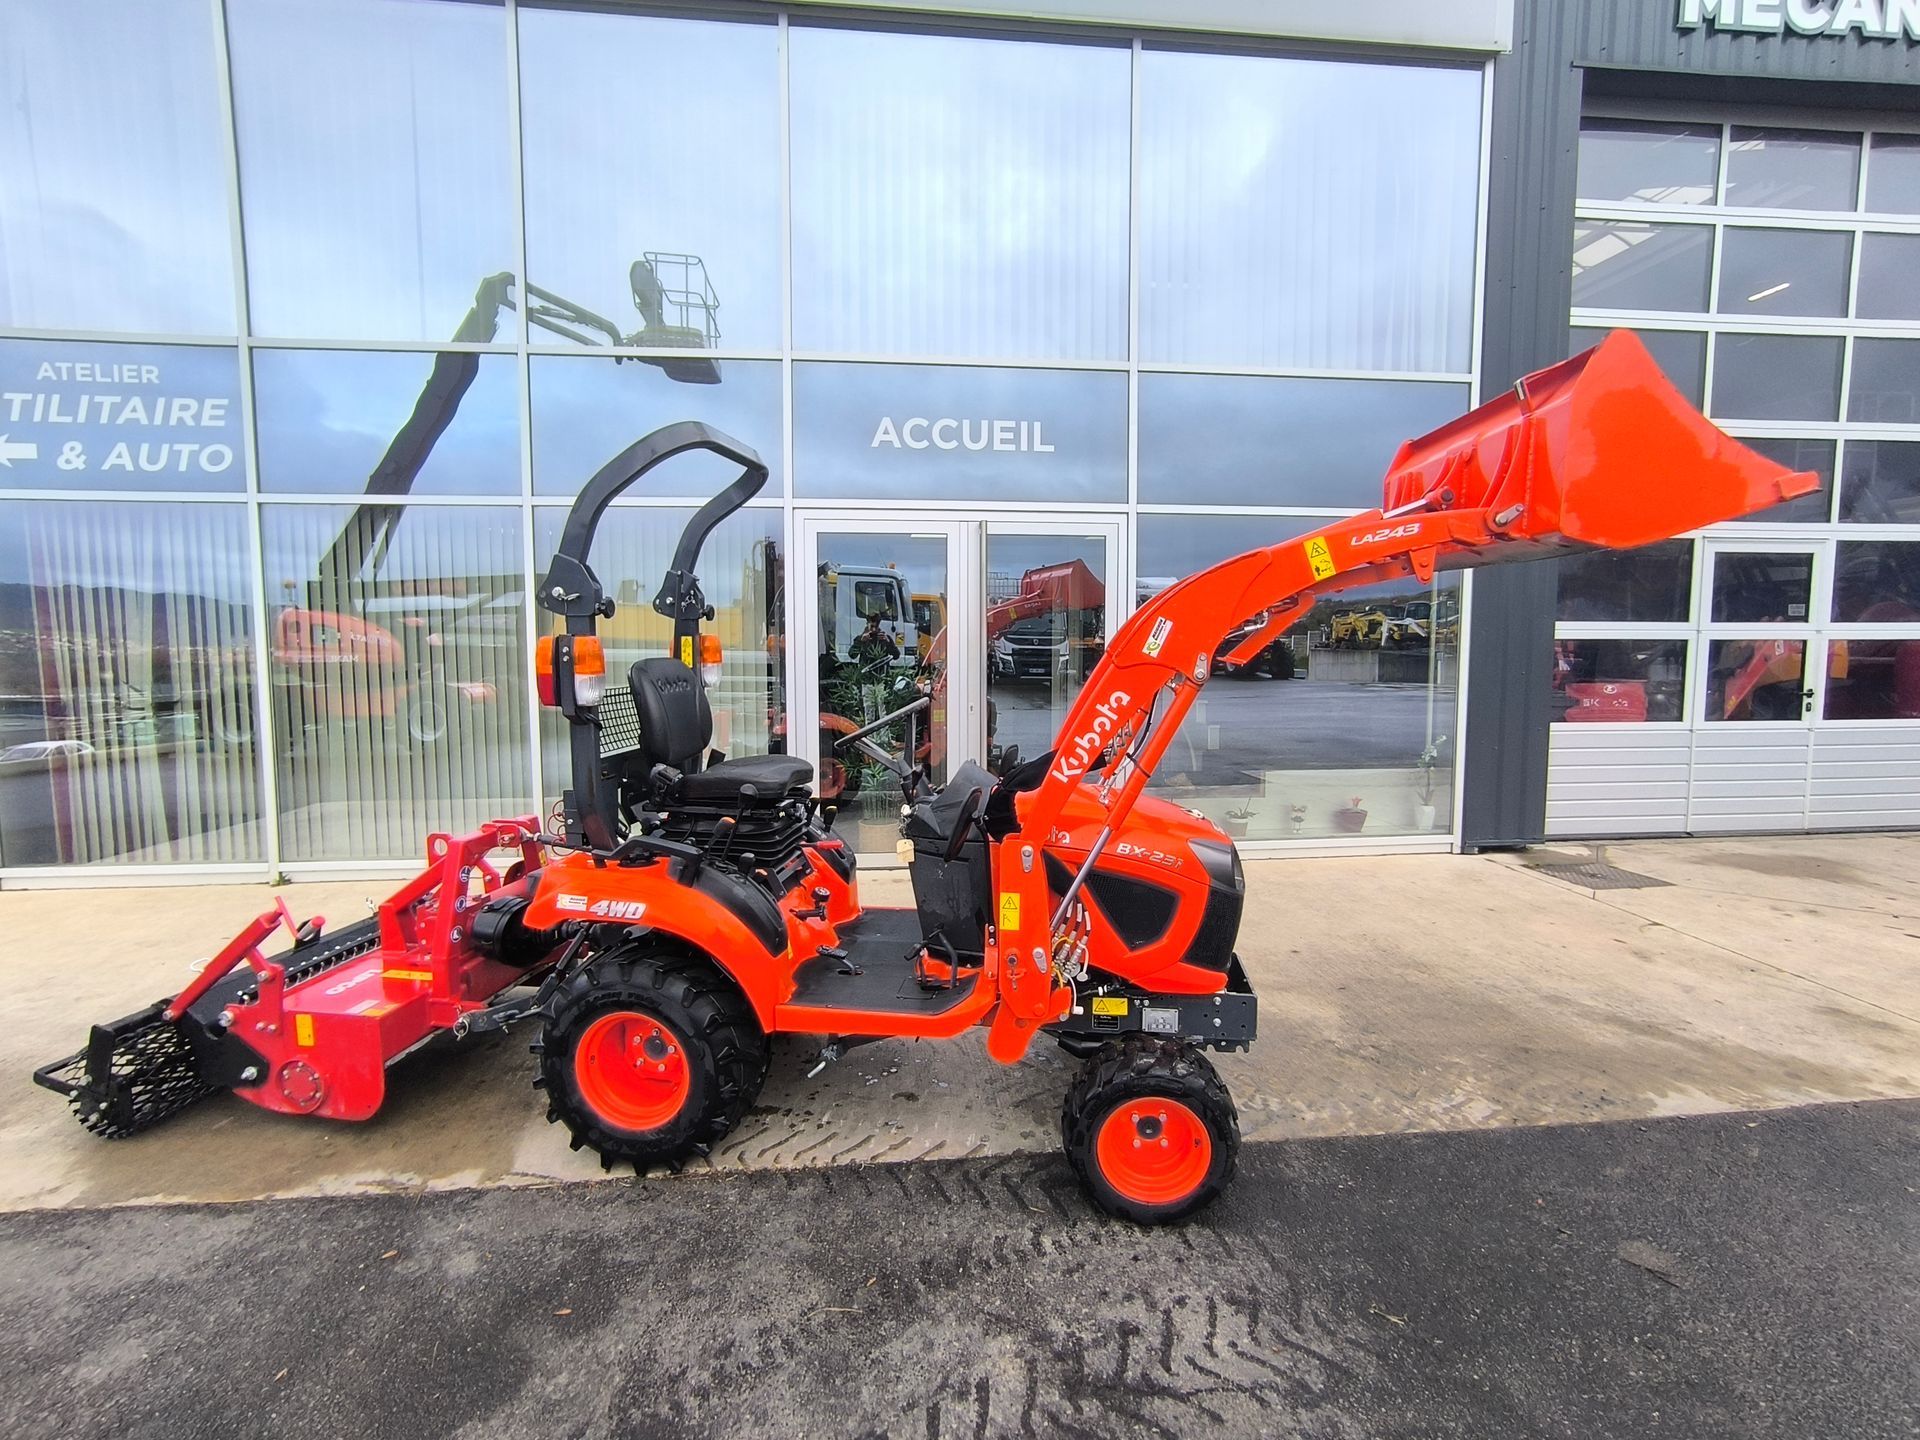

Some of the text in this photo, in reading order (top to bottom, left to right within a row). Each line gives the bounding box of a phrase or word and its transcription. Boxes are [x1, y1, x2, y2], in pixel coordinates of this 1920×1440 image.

[36, 361, 160, 384] ATELIER
[3, 392, 229, 427] TILITAIRE
[870, 416, 1055, 452] ACCUEIL
[56, 440, 234, 473] & AUTO
[1350, 522, 1422, 546] LA243
[1051, 690, 1131, 784] Kubota
[589, 899, 647, 919] 4WD
